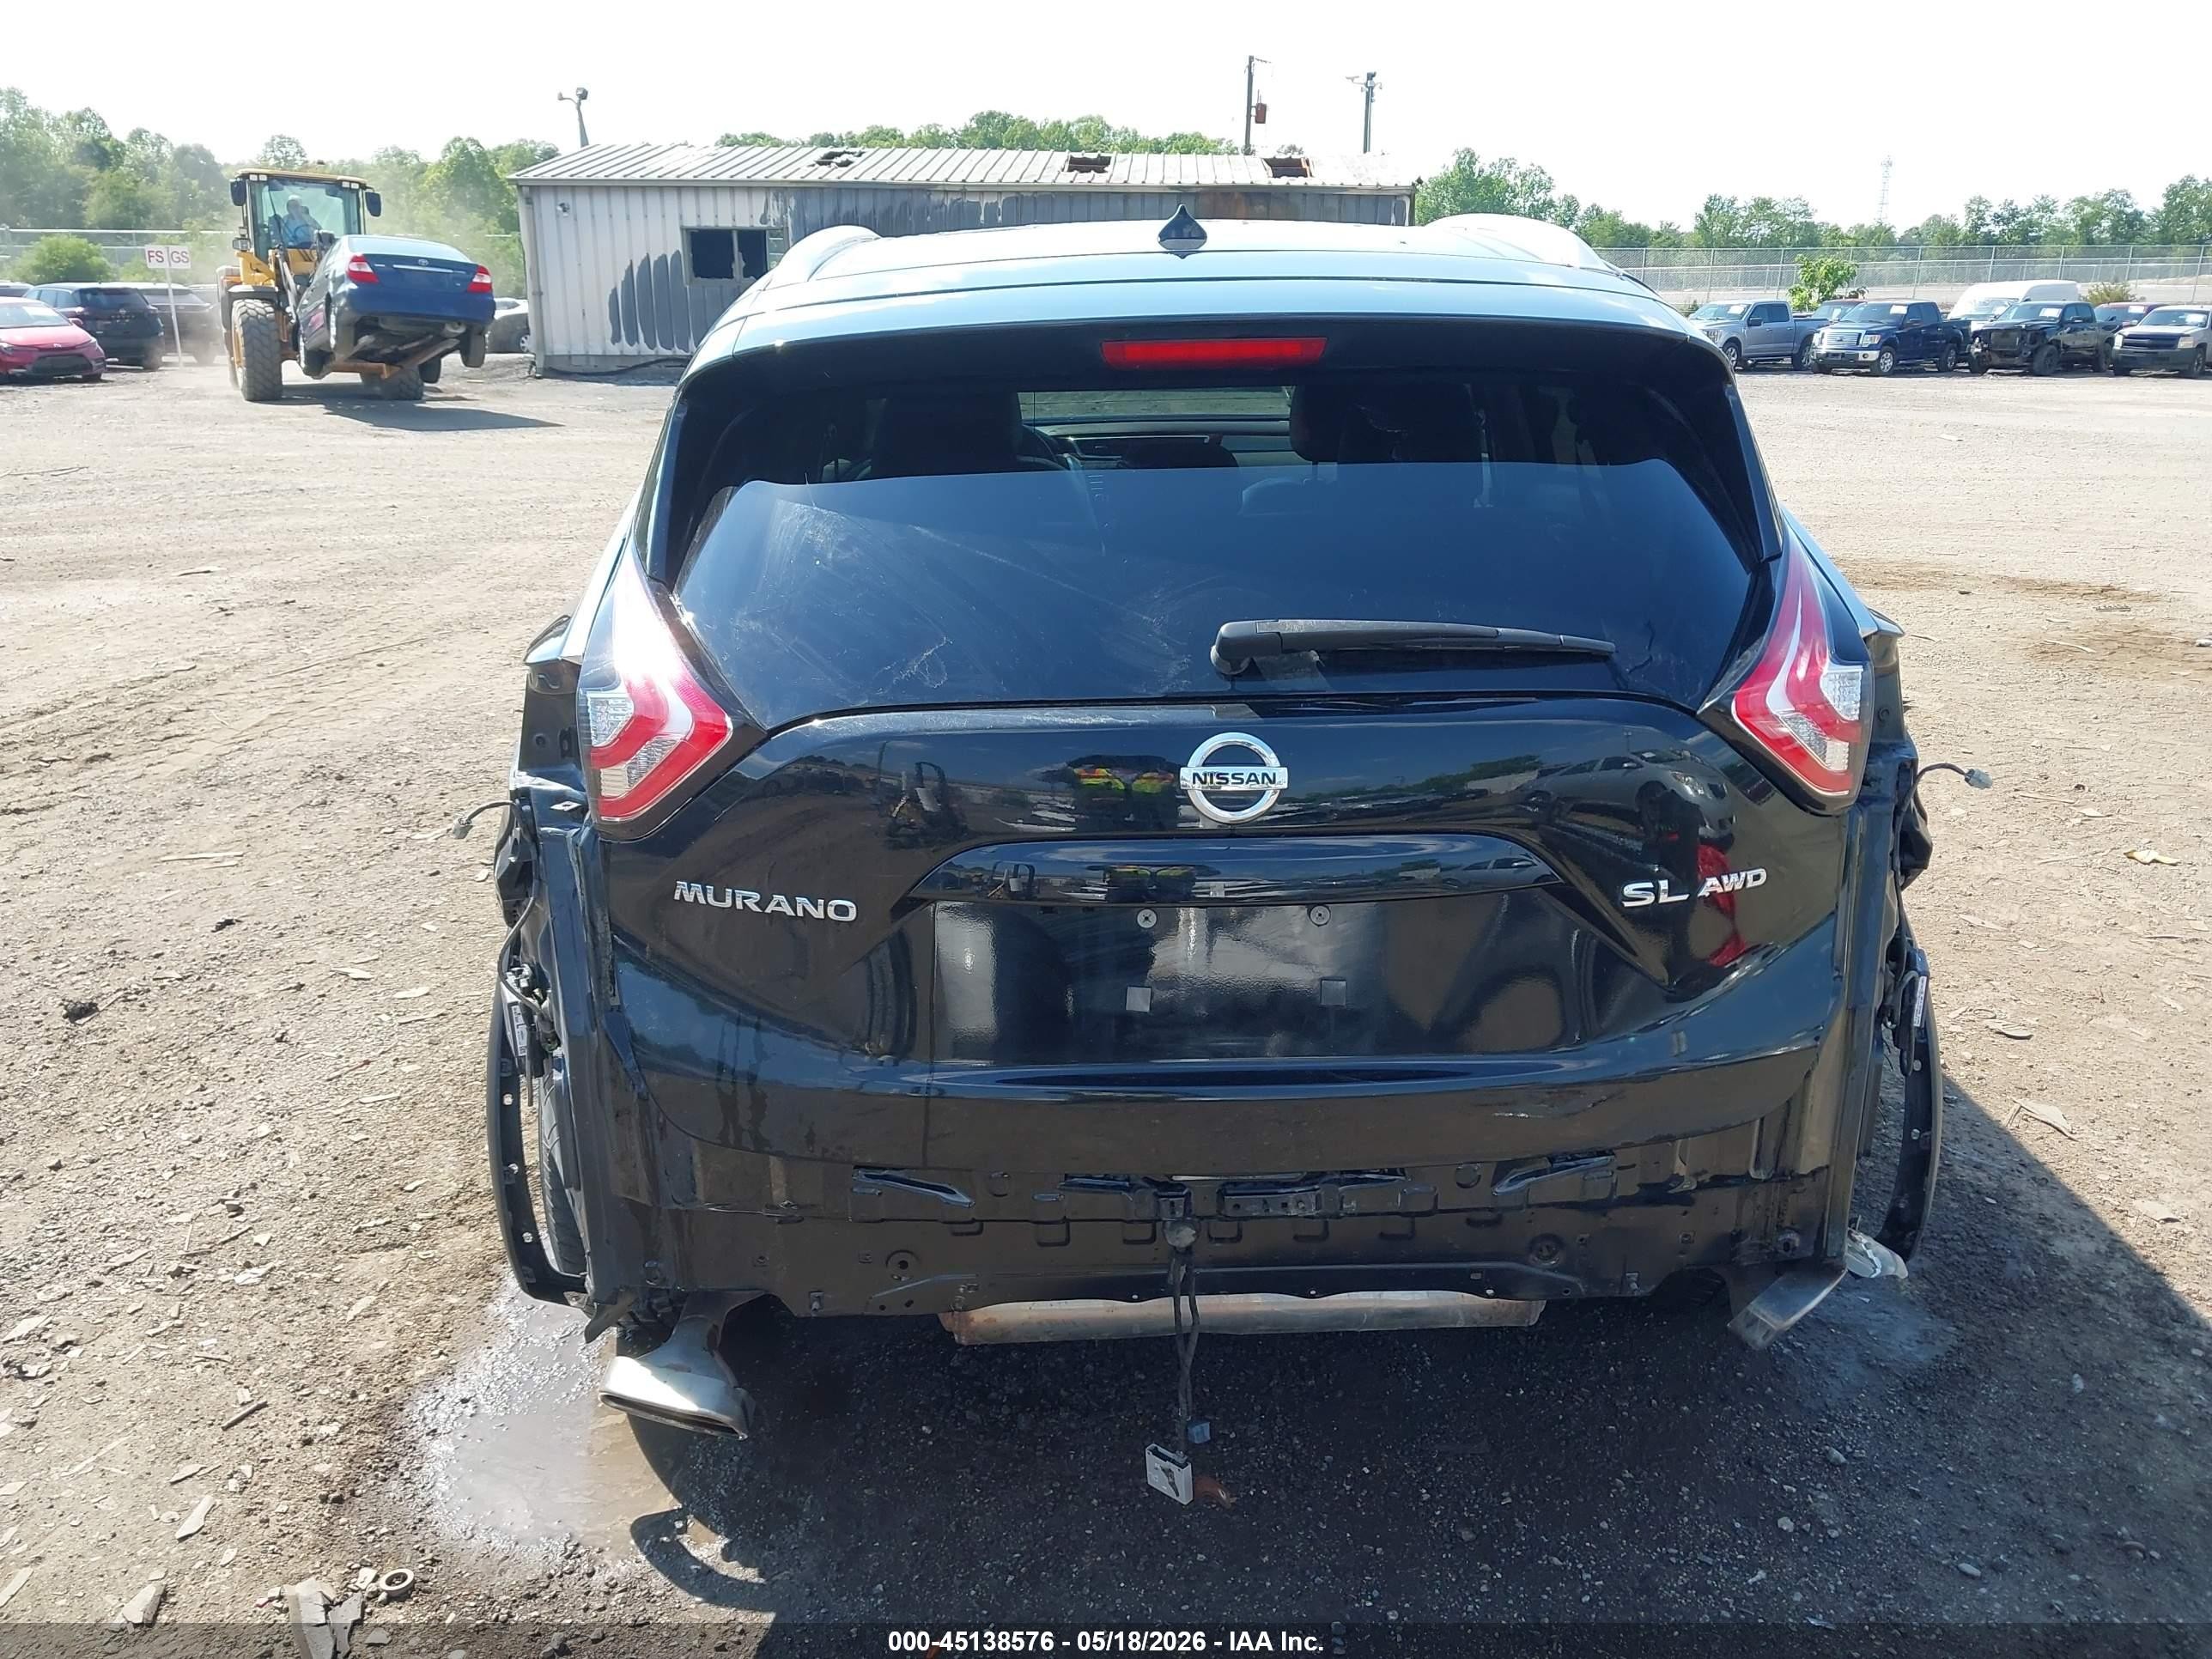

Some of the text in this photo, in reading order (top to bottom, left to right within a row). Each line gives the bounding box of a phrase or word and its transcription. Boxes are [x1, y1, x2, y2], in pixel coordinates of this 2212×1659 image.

[147, 250, 164, 263] FS
[171, 251, 189, 264] GS
[1192, 772, 1276, 785] NISSAN
[1622, 867, 1767, 908] SL AWD
[674, 880, 858, 922] MURANO
